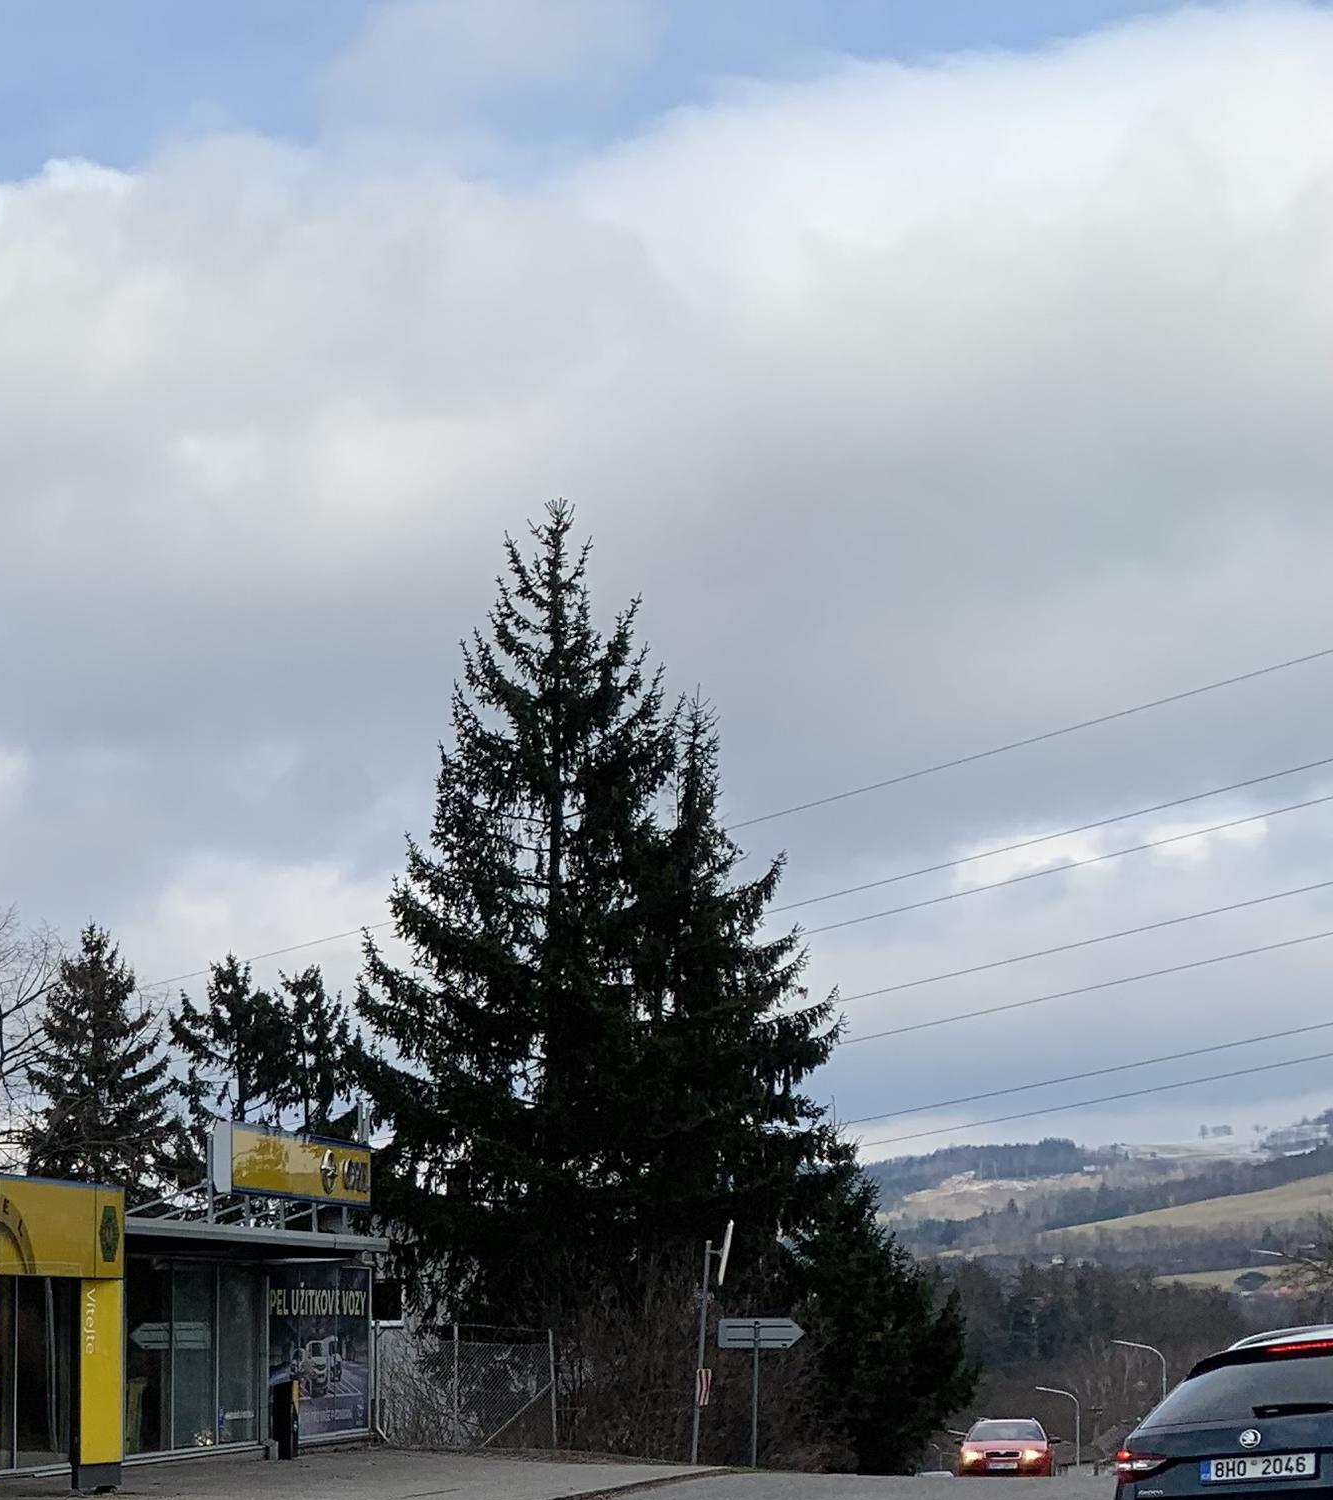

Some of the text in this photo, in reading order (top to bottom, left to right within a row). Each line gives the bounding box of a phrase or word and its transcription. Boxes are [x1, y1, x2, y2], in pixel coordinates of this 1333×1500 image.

[269, 1289, 289, 1316] PEL
[342, 1290, 367, 1316] VOZY
[1262, 1457, 1306, 1475] 2046
